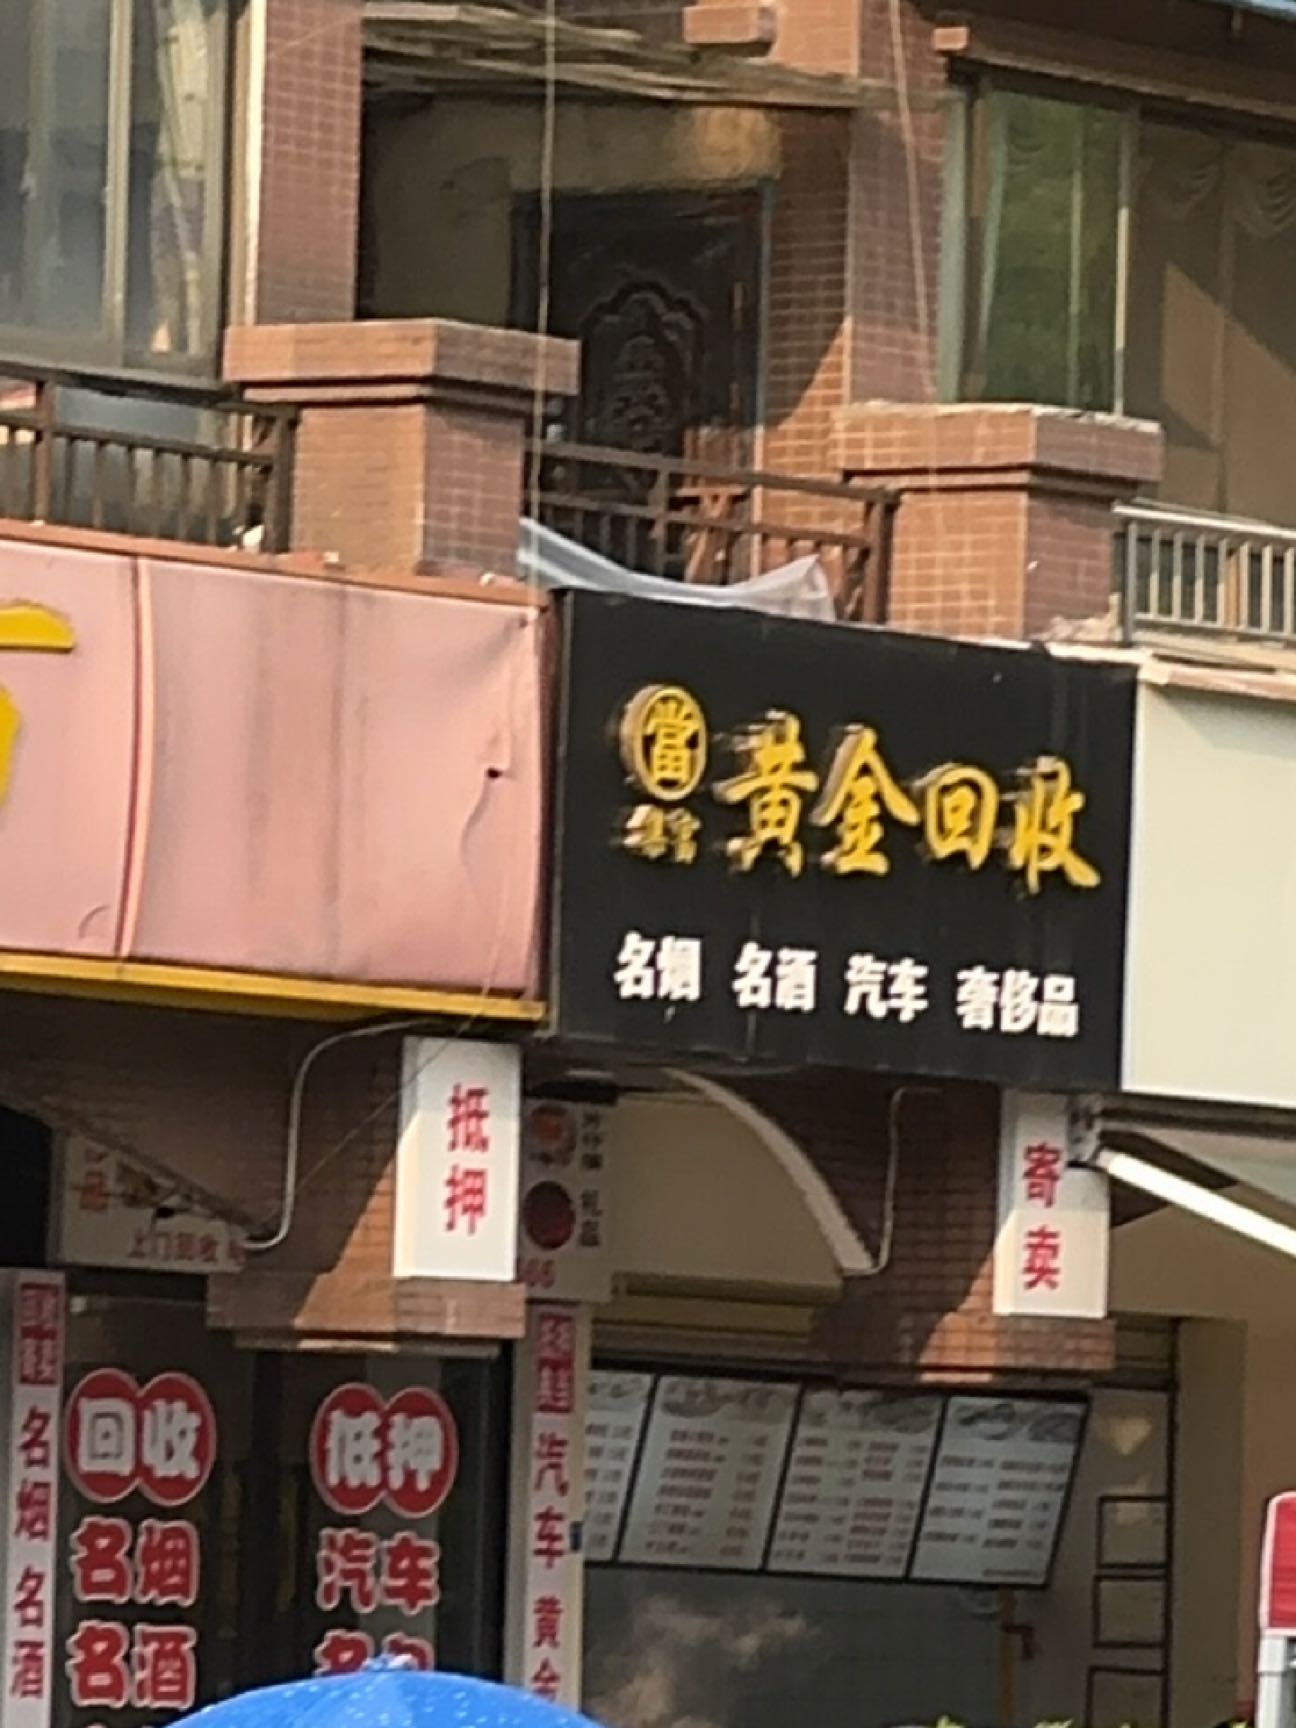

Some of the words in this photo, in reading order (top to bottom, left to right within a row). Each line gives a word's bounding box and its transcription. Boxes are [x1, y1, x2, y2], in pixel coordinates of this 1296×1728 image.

[712, 709, 1100, 893] 黄金回收
[613, 931, 702, 1001] 名烟
[731, 942, 818, 1012] 名酒
[843, 953, 929, 1022] 汽车
[955, 966, 1080, 1038] 奢侈品
[444, 1081, 490, 1237] 抵押
[1022, 1140, 1061, 1292] 寄卖
[78, 1398, 202, 1480] 回收
[70, 1515, 200, 1607] 名烟
[317, 1528, 440, 1616] 汽车
[66, 1619, 198, 1711] 名酒
